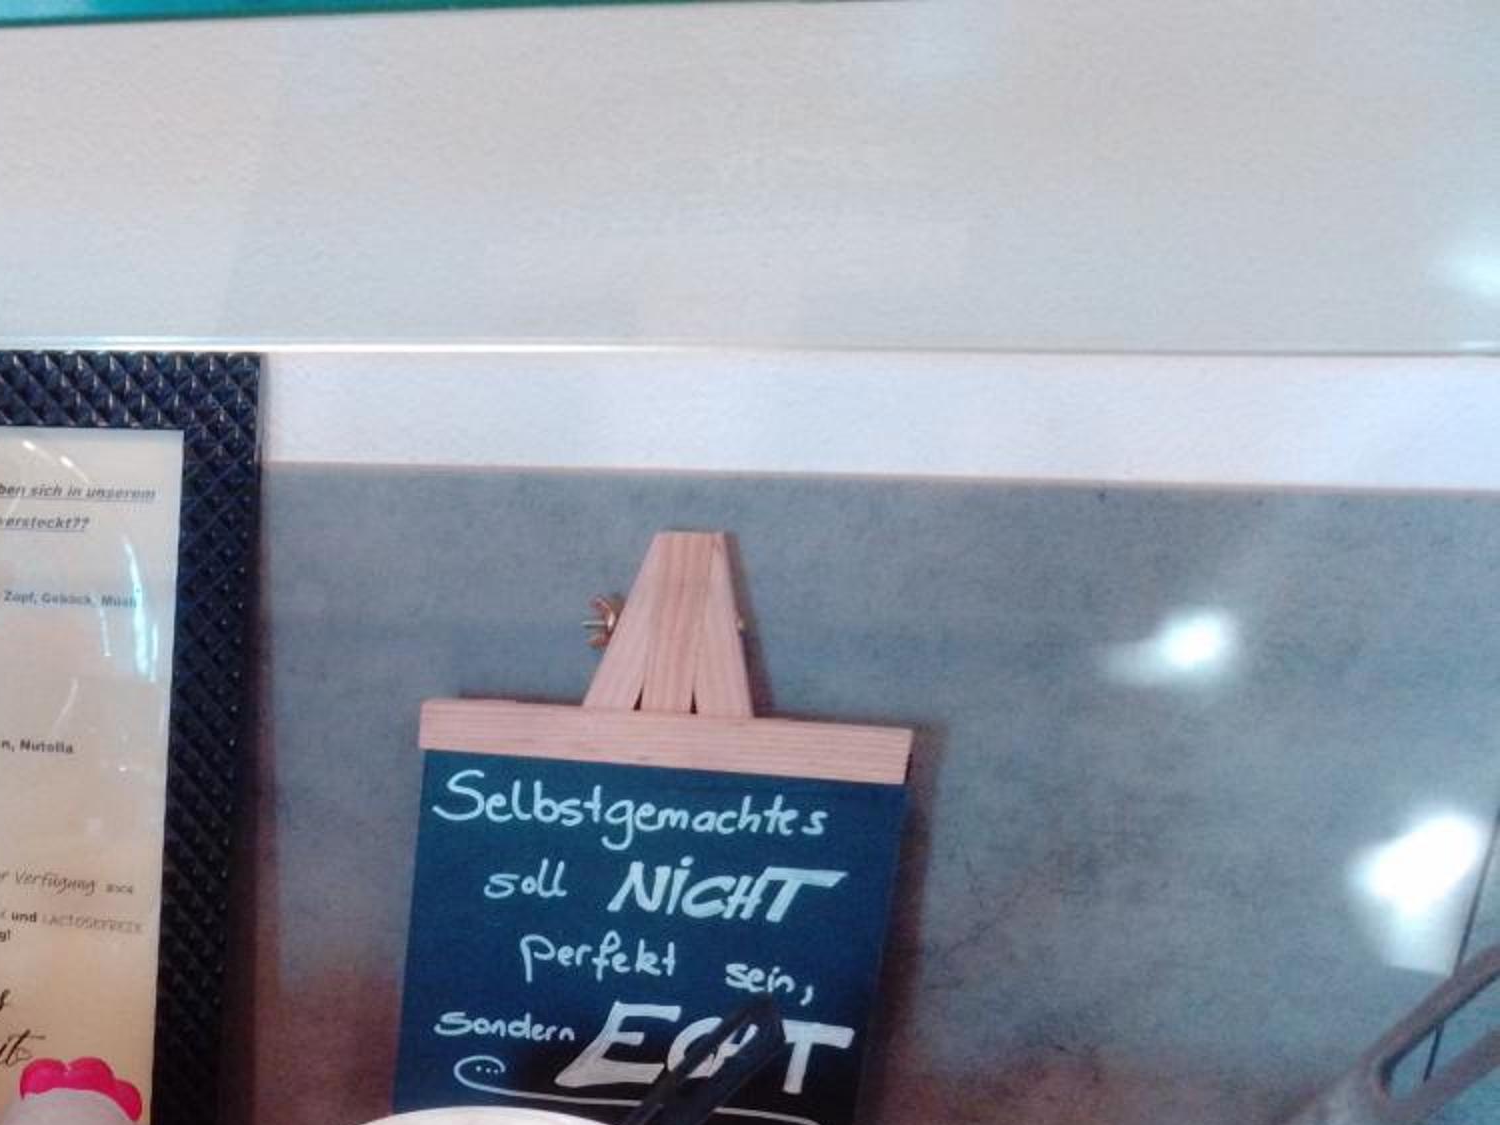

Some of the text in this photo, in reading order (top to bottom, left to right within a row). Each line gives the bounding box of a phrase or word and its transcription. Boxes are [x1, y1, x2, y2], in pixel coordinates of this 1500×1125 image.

[30, 483, 62, 497] sich
[67, 483, 83, 497] in
[432, 769, 828, 850] Selbstgemachtes
[14, 870, 96, 897] Verfügung
[484, 858, 568, 898] soll
[11, 911, 37, 923] und
[519, 930, 813, 1005] perfekt sein,
